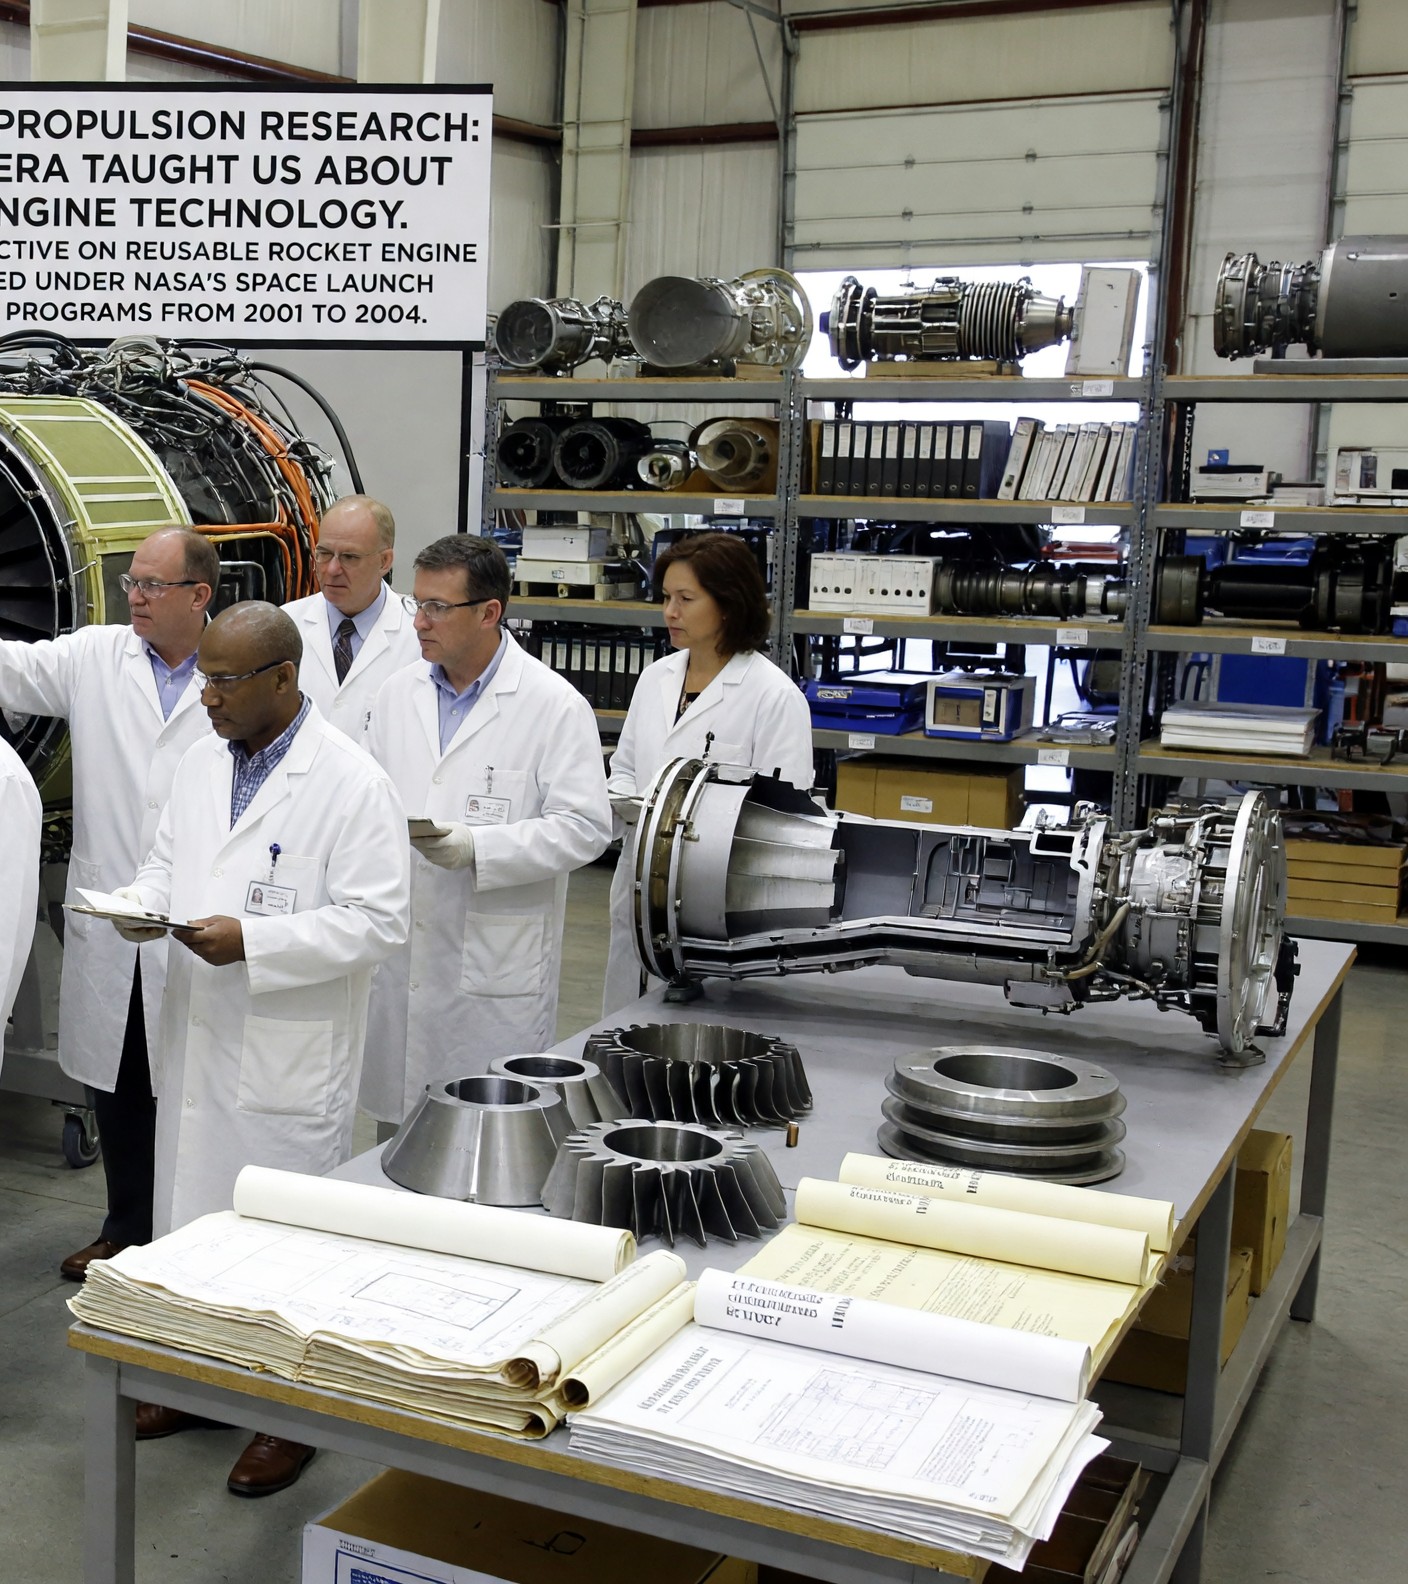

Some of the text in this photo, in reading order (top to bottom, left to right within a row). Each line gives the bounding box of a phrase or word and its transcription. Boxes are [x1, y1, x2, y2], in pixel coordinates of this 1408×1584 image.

[260, 110, 482, 142] RESEARCH:
[82, 153, 240, 185] TAUGHT
[253, 154, 302, 185] US
[314, 155, 453, 186] ABOUT
[129, 197, 409, 230] TECHNOLOGY.
[78, 240, 116, 261] ON
[126, 241, 260, 261] REUSABLE
[268, 241, 373, 262] ROCKET
[381, 242, 477, 263] ENGINE
[35, 271, 125, 292] UNDER
[134, 271, 227, 292] NASA'S
[235, 272, 318, 293] SPACE
[327, 273, 433, 293] LAUNCH
[6, 301, 153, 322] PROGRAMS
[161, 302, 235, 323] FROM
[243, 303, 303, 323] 2001
[311, 303, 347, 324] TO
[354, 303, 429, 324] 2004.
